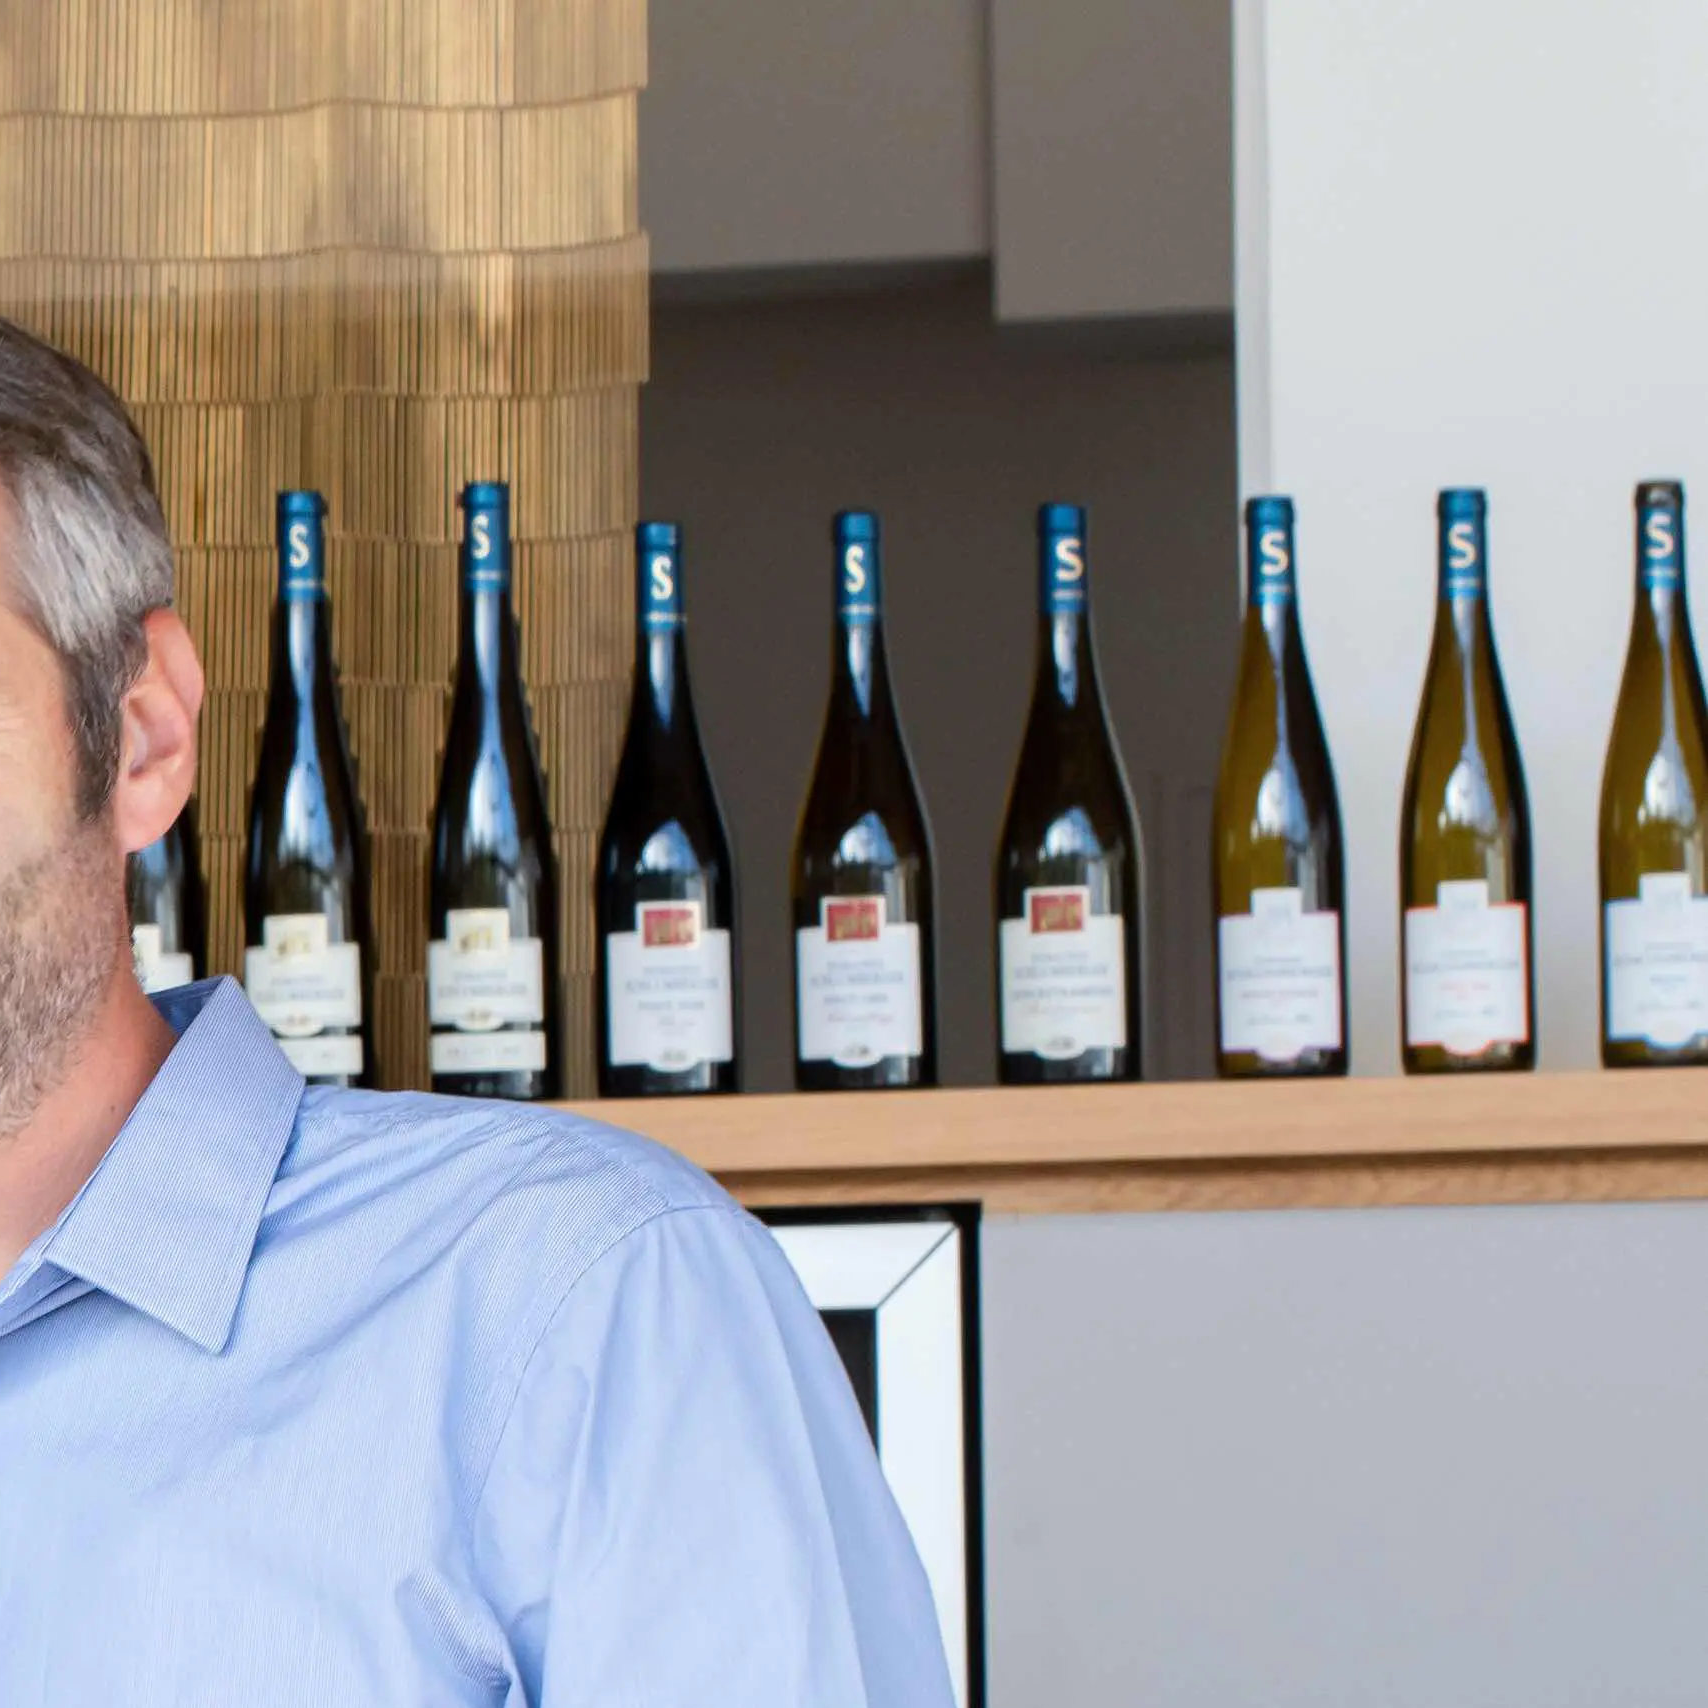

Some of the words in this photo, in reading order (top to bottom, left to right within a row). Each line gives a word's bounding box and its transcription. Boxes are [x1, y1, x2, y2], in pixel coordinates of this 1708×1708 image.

[289, 522, 311, 569] S
[471, 512, 493, 560] S
[1056, 537, 1084, 581] S
[1259, 530, 1289, 577] S
[1447, 521, 1478, 570] S
[1645, 511, 1676, 560] S
[650, 555, 675, 602] S
[844, 544, 867, 594] S
